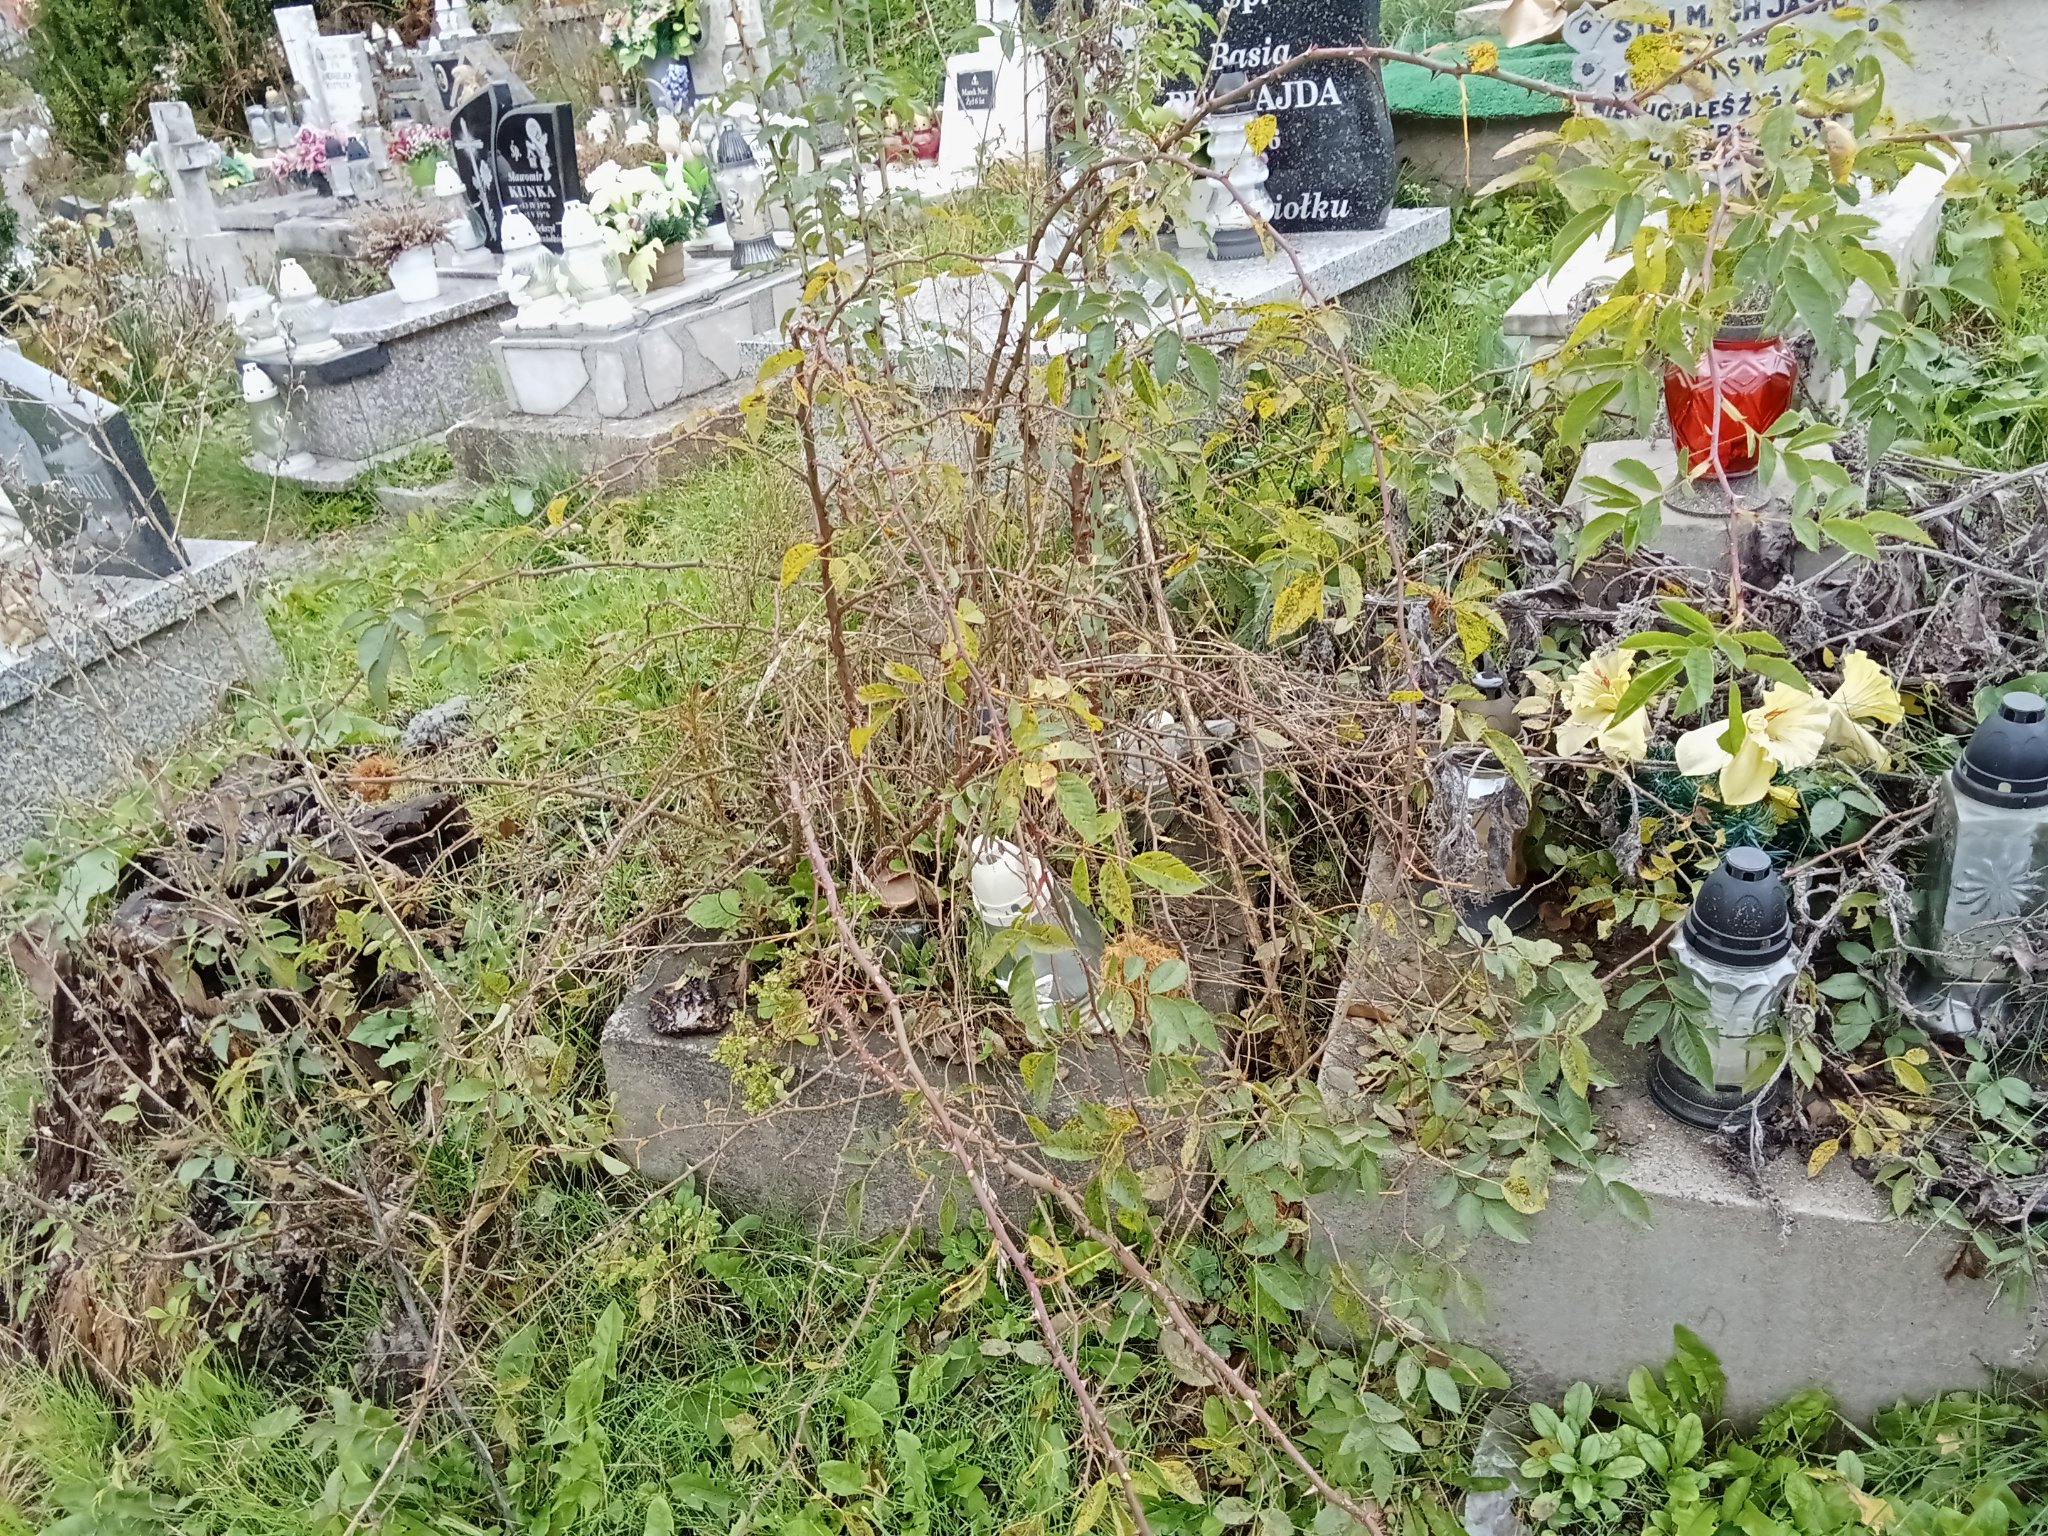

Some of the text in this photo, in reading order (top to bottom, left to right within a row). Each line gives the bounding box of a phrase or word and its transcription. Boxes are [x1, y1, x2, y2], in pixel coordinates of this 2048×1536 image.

[1210, 36, 1292, 71] Basia
[508, 185, 557, 199] KUNKA
[1271, 191, 1351, 221] iołku
